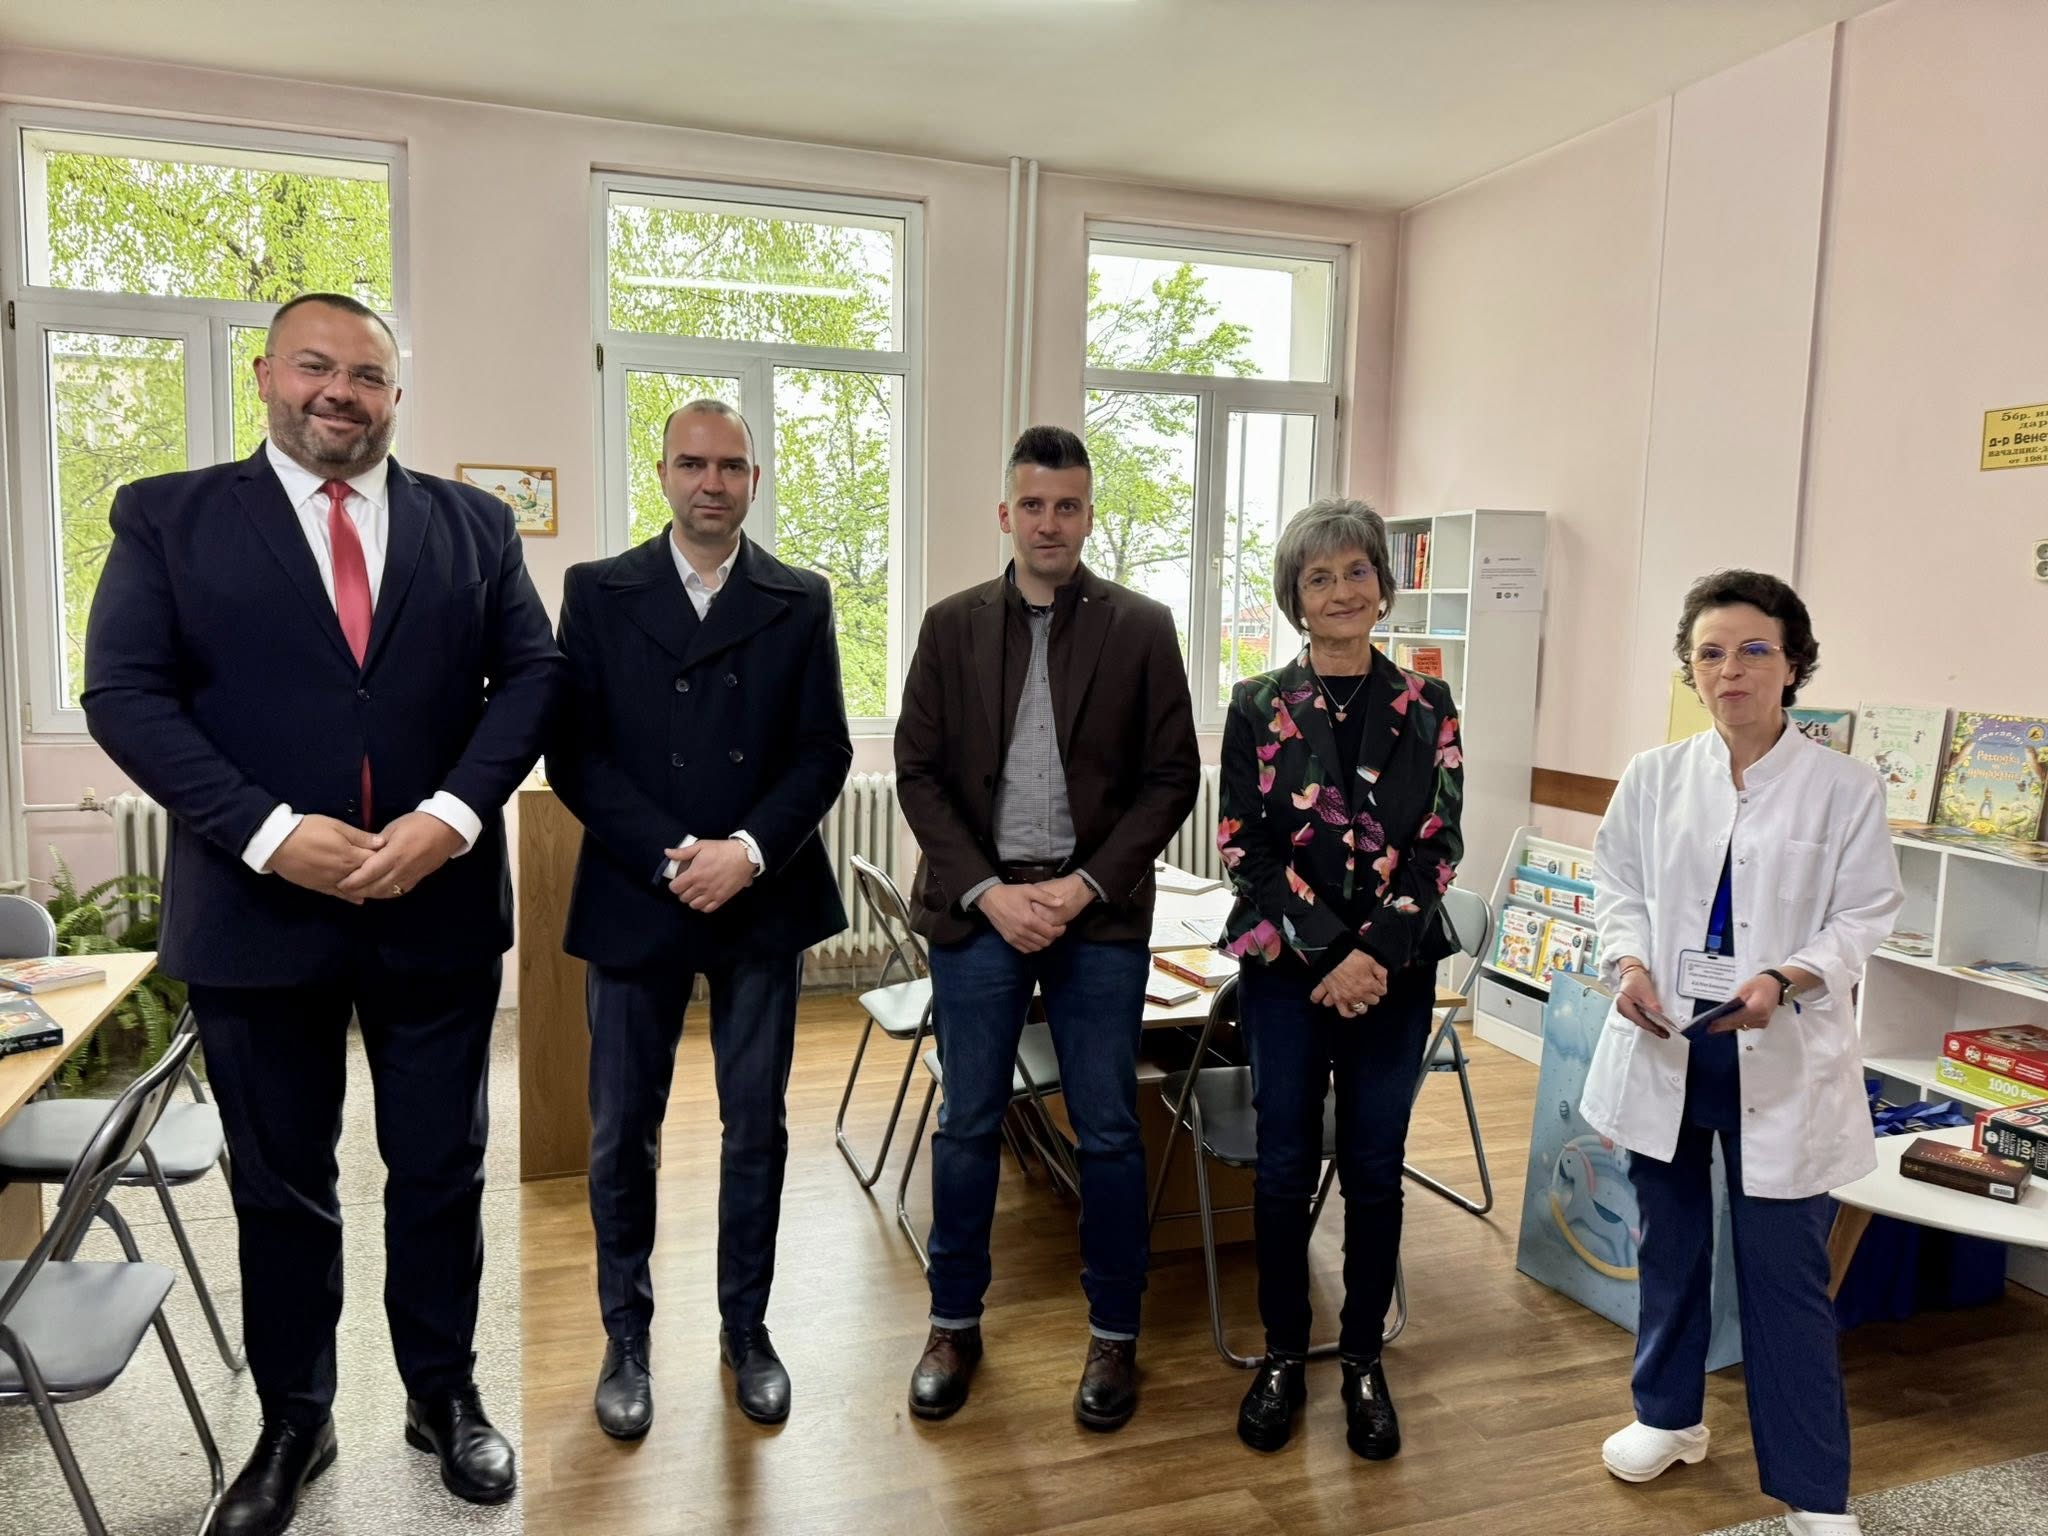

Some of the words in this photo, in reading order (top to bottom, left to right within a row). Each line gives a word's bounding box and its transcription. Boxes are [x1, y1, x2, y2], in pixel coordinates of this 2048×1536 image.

[1988, 436, 2010, 447] д-р
[2014, 432, 2048, 445] Вене
[1988, 1077, 2019, 1097] 1000
[2020, 1139, 2032, 1160] 100
